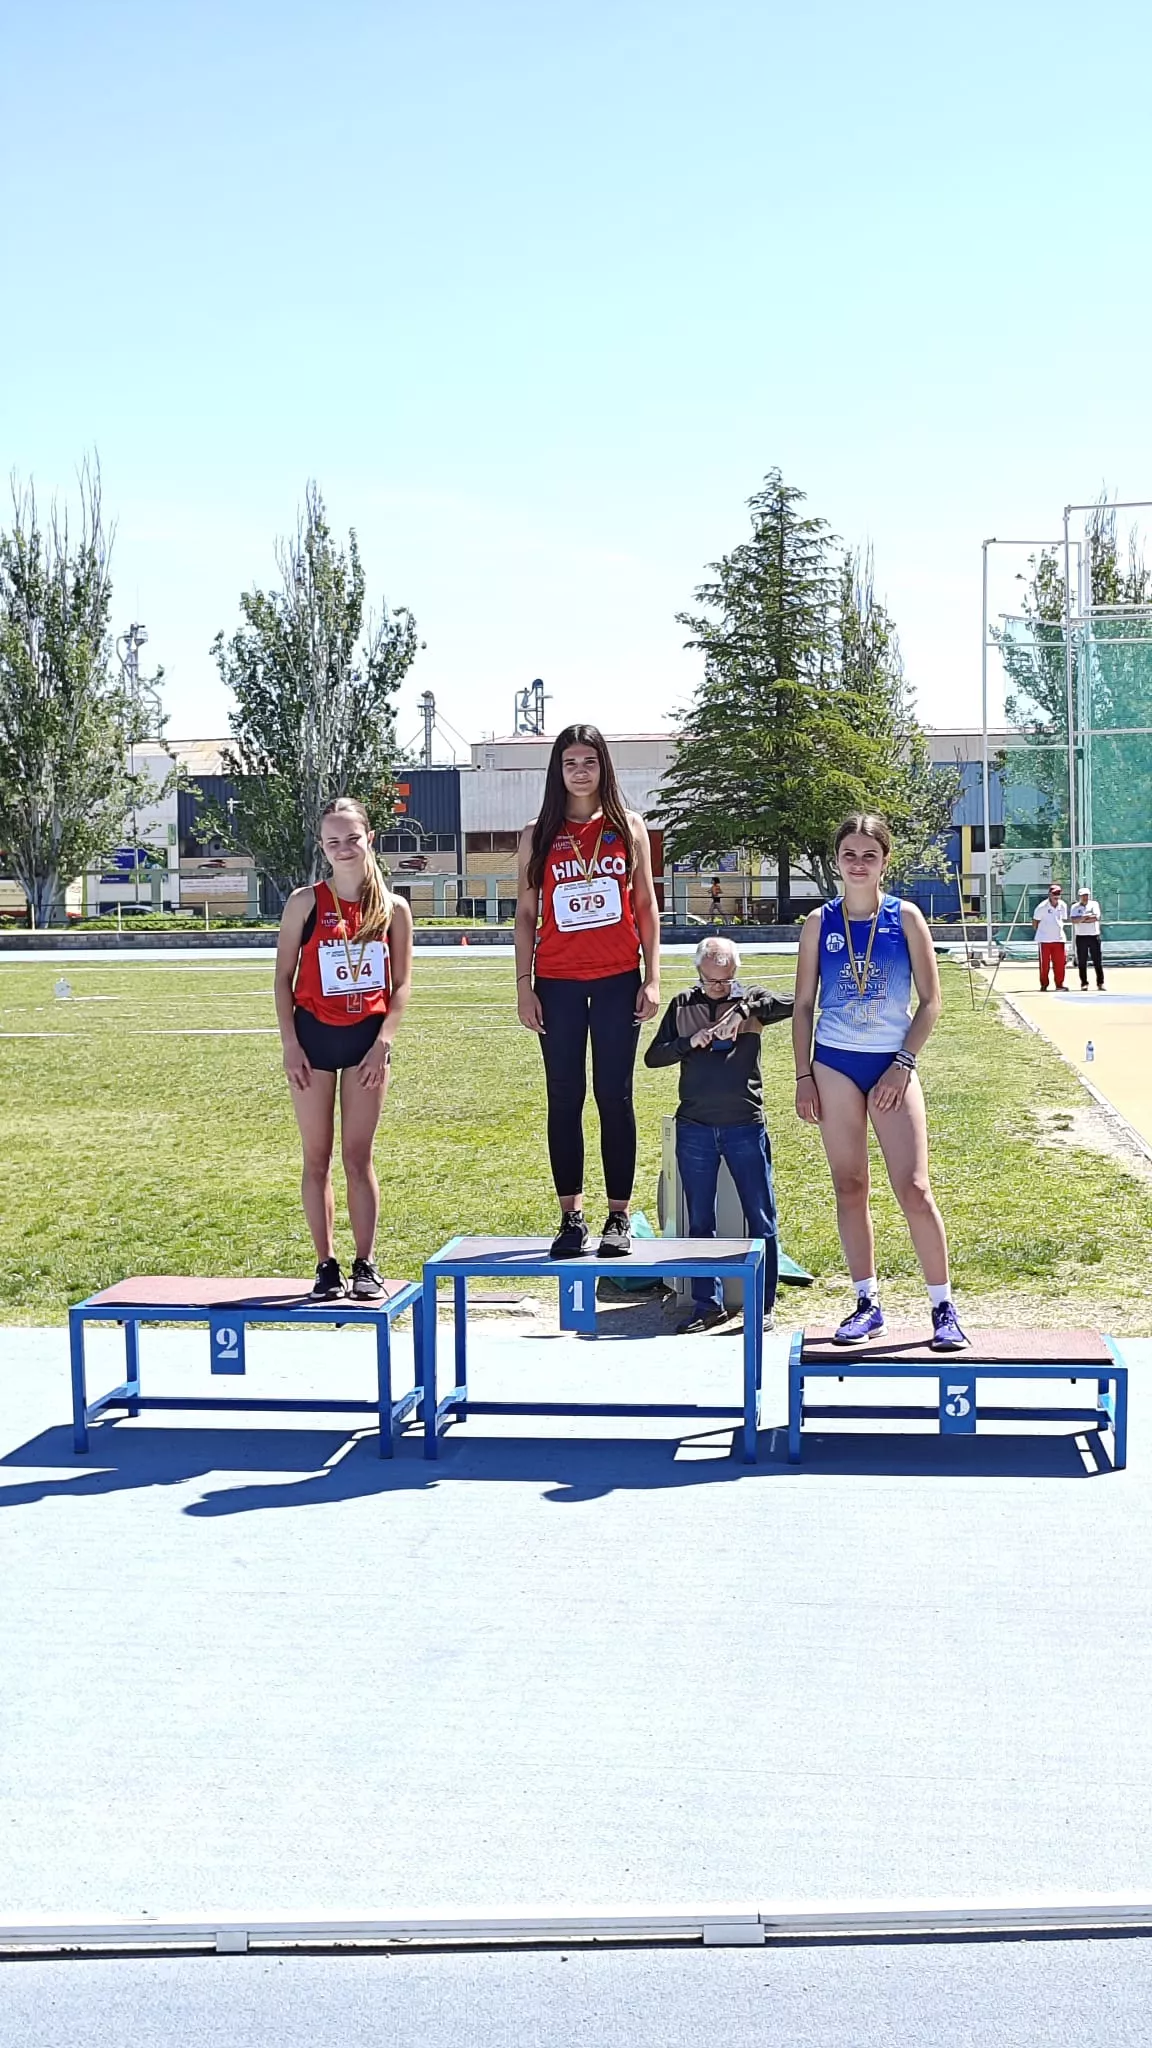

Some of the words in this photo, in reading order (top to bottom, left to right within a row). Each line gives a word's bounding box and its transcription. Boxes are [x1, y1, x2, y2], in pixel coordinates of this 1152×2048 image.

[569, 894, 605, 913] 679
[567, 1280, 585, 1312] 1
[216, 1328, 239, 1358] 2
[945, 1385, 971, 1417] 3
